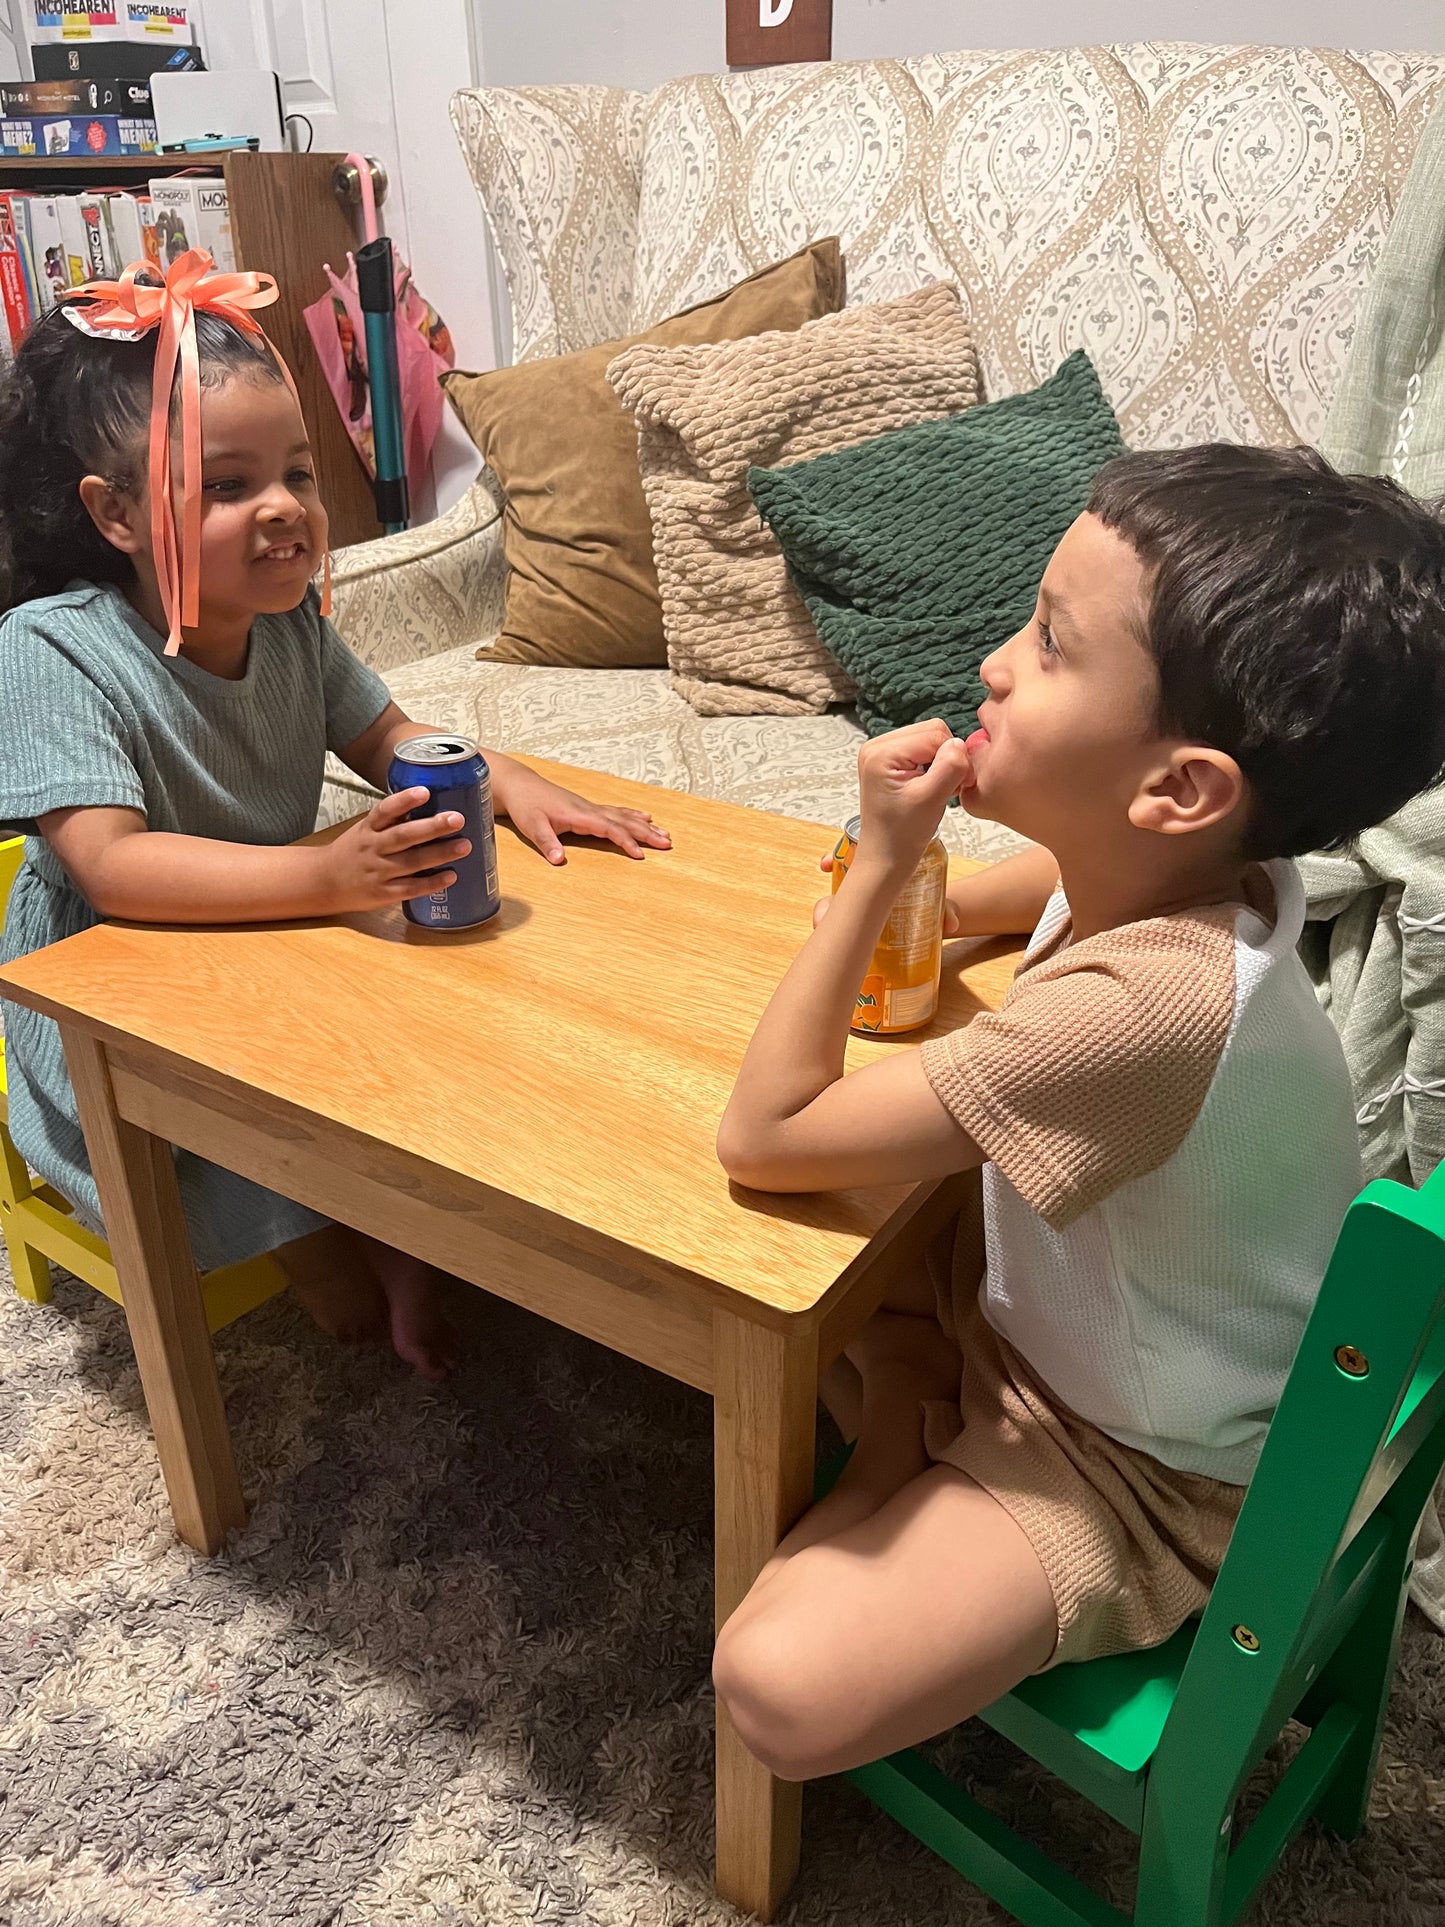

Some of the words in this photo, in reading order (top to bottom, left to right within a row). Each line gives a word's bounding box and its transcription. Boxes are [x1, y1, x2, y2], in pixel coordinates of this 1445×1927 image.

[35, 0, 116, 15] INCOHEARENT
[127, 4, 187, 18] INCOHEARENT
[128, 86, 150, 99] Clue
[154, 191, 189, 200] MONOPOLY
[202, 192, 228, 208] MON
[89, 225, 104, 276] NNECT
